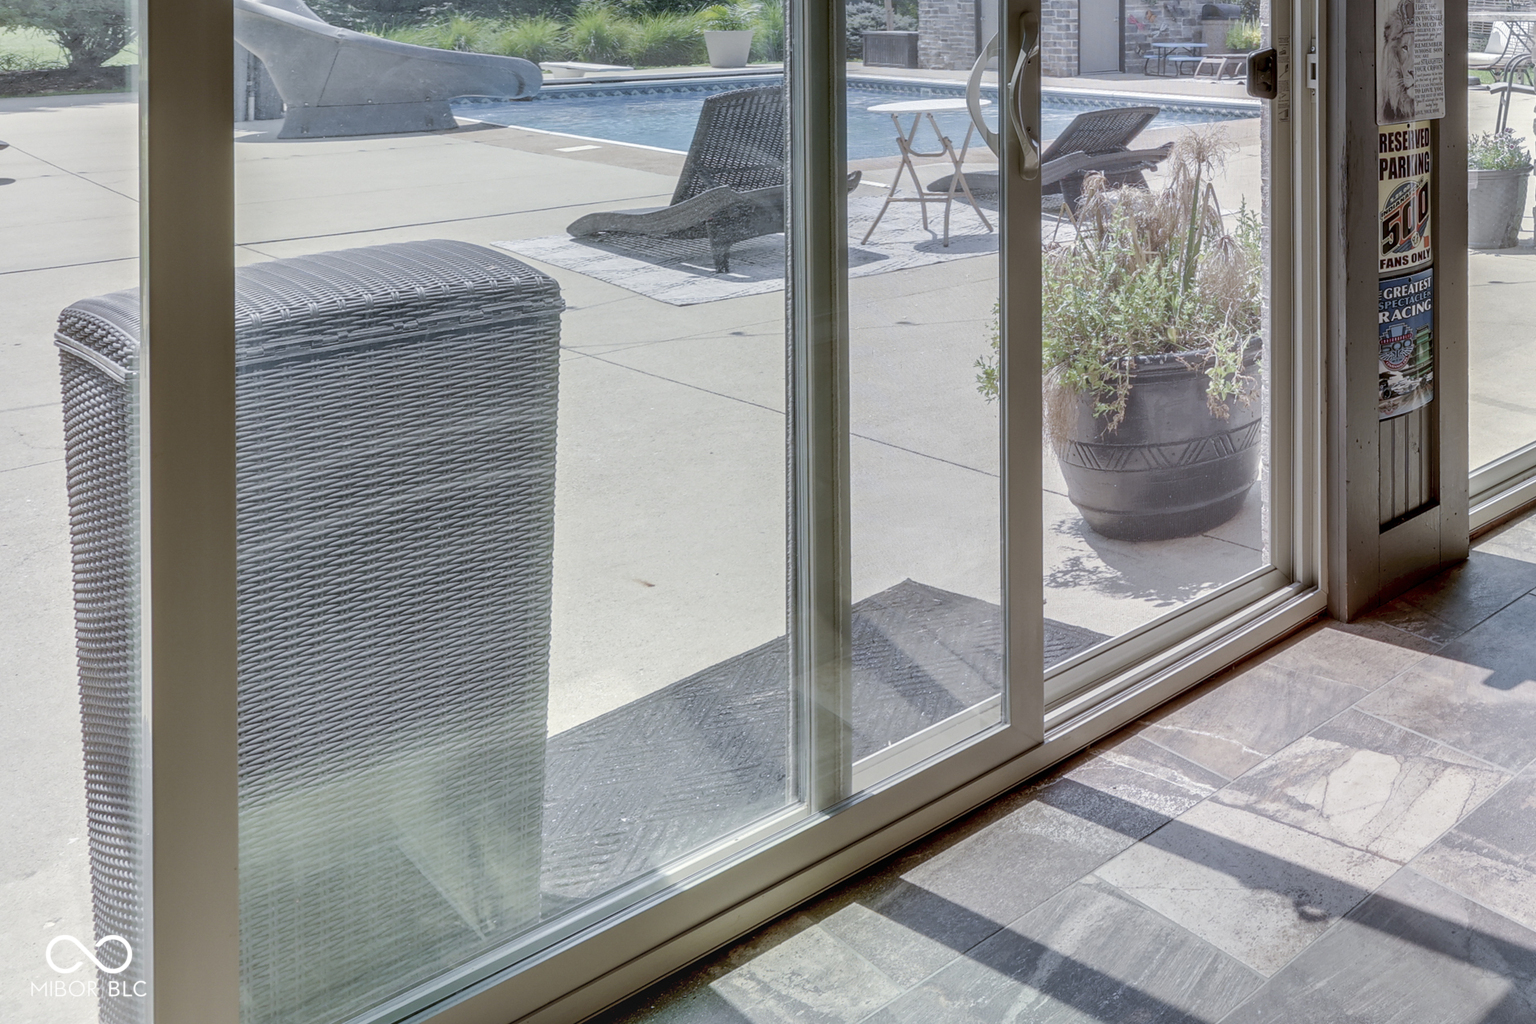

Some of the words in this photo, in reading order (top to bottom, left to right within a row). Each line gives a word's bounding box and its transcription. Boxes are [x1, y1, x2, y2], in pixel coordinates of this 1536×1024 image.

[1378, 126, 1430, 154] RESERVED
[1378, 150, 1430, 181] PARKING
[1381, 178, 1430, 256] 500
[1380, 254, 1409, 270] FANS
[1411, 247, 1431, 264] ONLY
[1378, 291, 1428, 311] SPECTACLE
[1383, 276, 1432, 300] GREATEST
[1378, 298, 1432, 324] RACING
